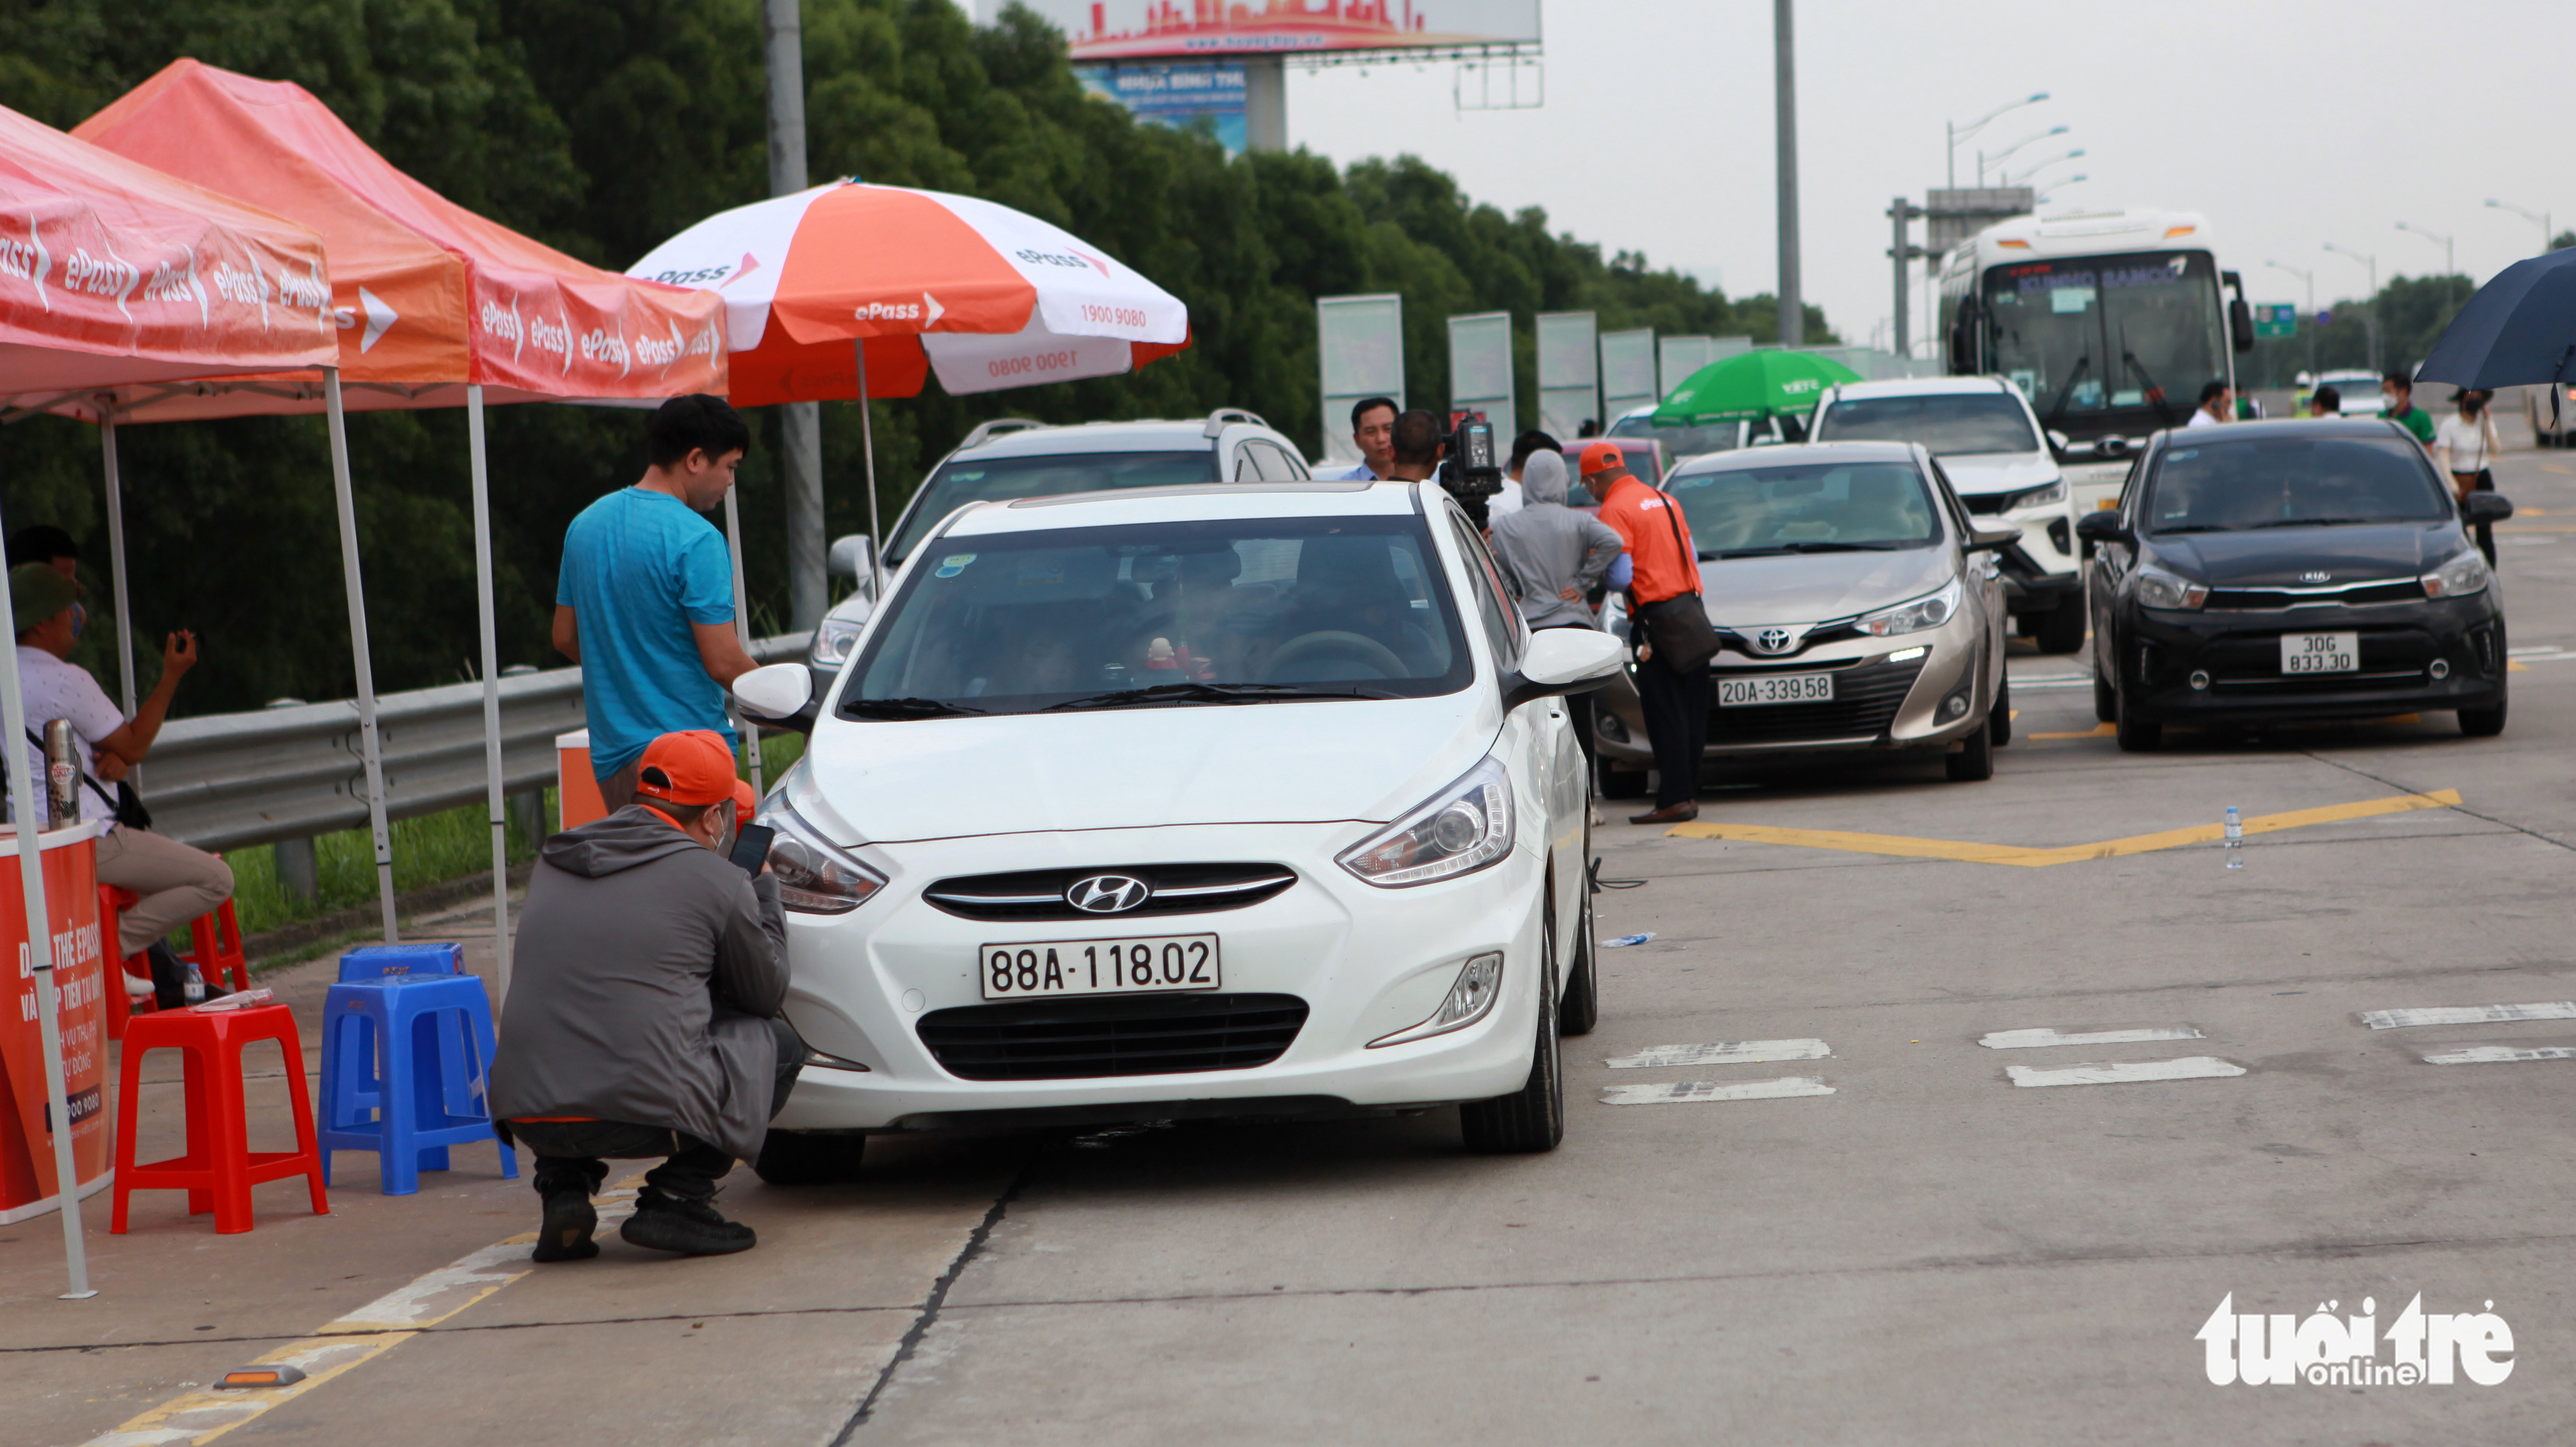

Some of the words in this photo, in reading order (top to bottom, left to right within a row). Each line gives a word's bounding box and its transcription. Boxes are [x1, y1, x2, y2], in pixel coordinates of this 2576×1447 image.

[65, 247, 125, 296] ePass
[1016, 249, 1089, 268] ePass
[144, 261, 193, 302] ePass
[214, 262, 258, 304] ePass
[279, 268, 320, 308] ePass
[482, 300, 515, 341] ePass
[855, 302, 919, 320] ePass
[1082, 304, 1113, 324] 1900
[1116, 308, 1147, 328] 9080
[531, 315, 565, 354] ePass
[581, 328, 623, 364] ePass
[636, 334, 675, 365] ePass
[2290, 654, 2350, 671] 833.30
[2304, 637, 2336, 652] 30G
[1723, 677, 1829, 703] 20A-339.58
[53, 918, 75, 970] THẺ
[76, 921, 99, 964] EPASS
[991, 941, 1211, 992] 88A-118.02
[20, 987, 38, 1022] VÀ
[63, 972, 81, 1011] TIỀN
[84, 1092, 100, 1113] 9080
